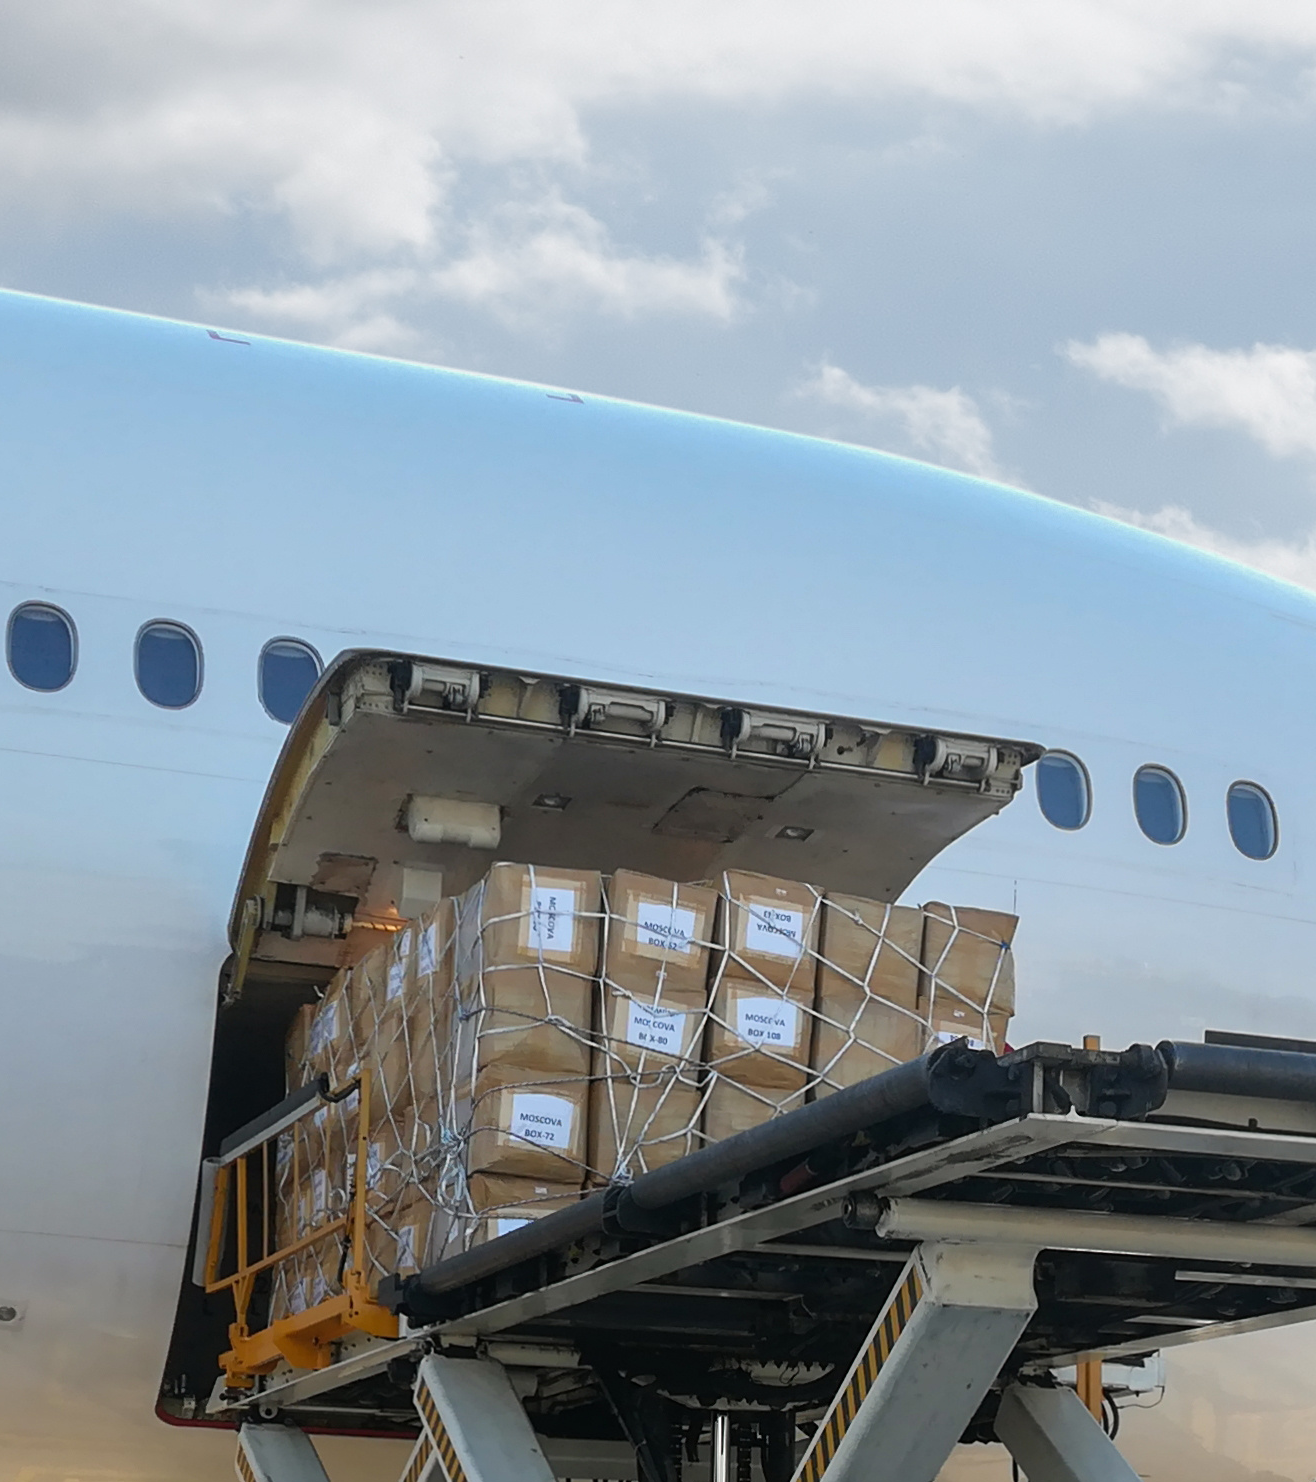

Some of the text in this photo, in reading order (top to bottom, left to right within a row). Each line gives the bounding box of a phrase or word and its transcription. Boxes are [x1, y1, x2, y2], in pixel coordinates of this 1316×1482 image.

[634, 1016, 675, 1032] MOCOVA
[520, 1112, 563, 1127] MOSCOVA
[524, 1129, 555, 1141] BOX-72
